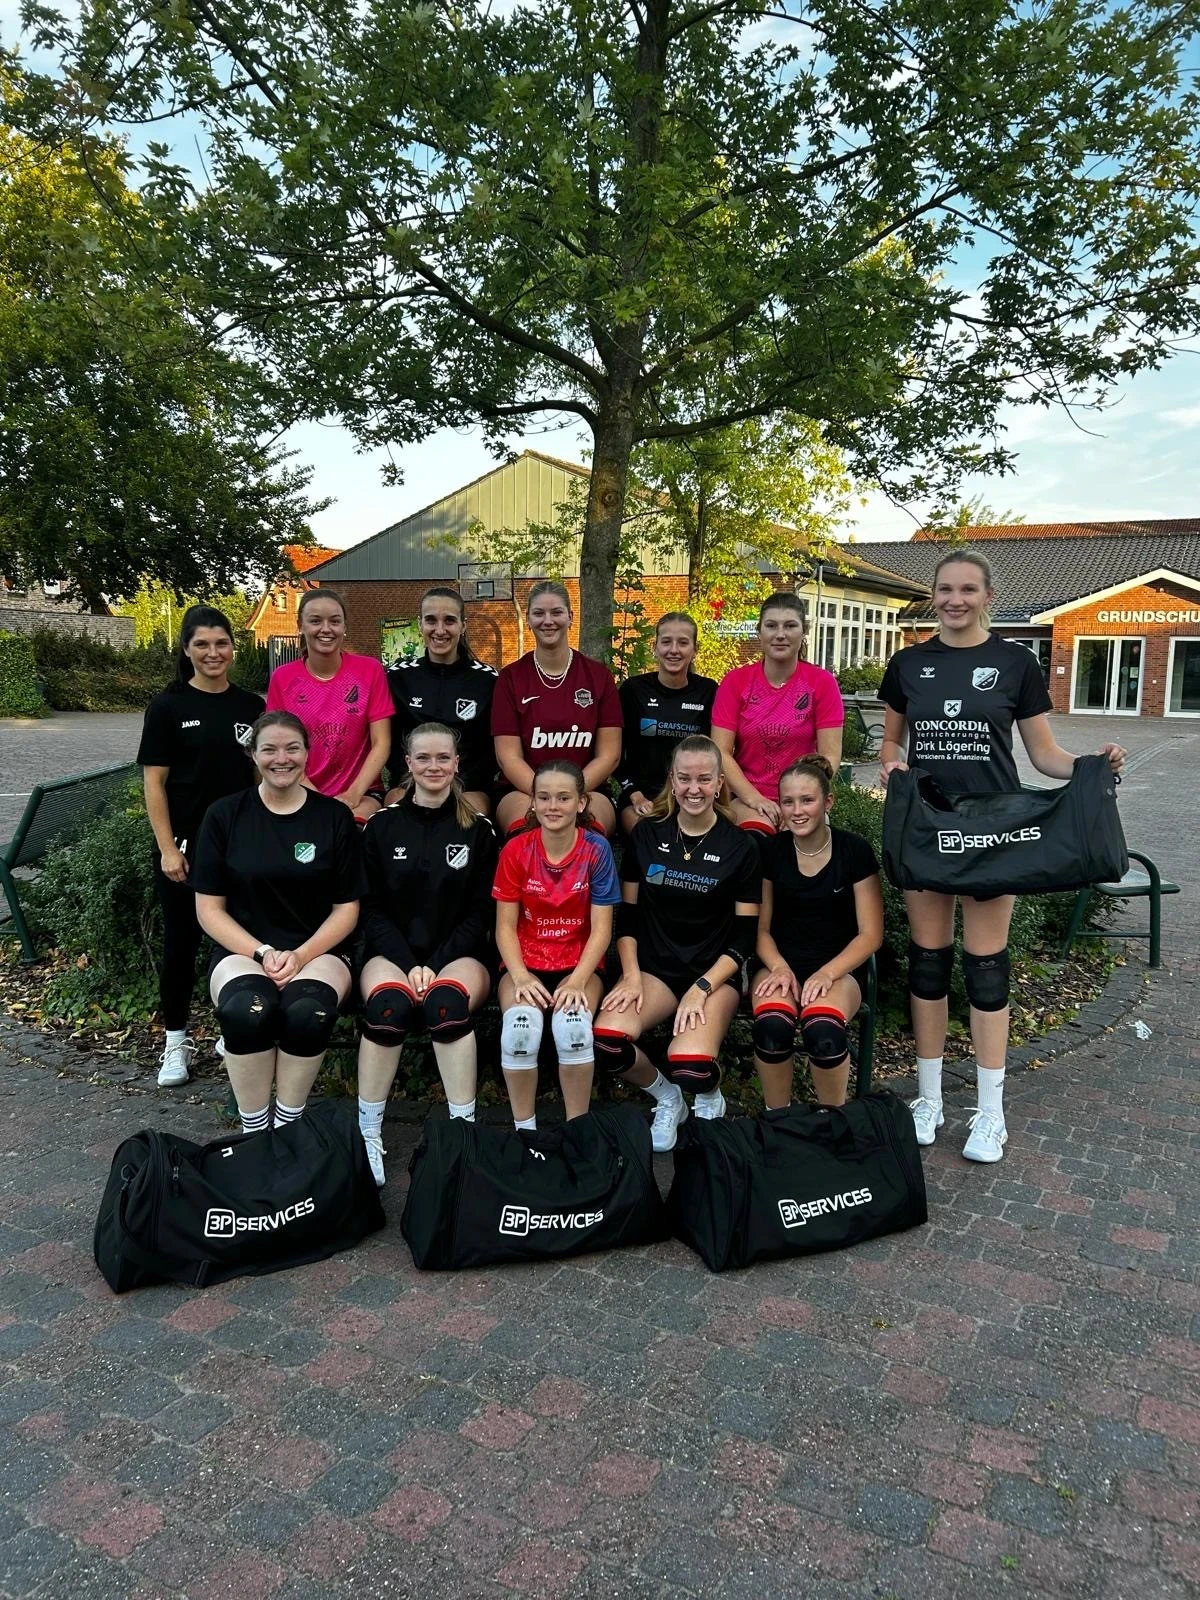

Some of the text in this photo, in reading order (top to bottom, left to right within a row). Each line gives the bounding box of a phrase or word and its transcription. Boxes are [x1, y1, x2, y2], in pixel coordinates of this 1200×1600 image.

[1097, 611, 1200, 623] GRUNDSCHU
[181, 720, 200, 728] JAKO
[658, 722, 702, 732] GRAFSCHAF
[915, 720, 989, 732] CONCORDIA
[530, 724, 593, 748] bwin
[916, 741, 991, 754] Dirk Lögering
[964, 827, 1041, 848] SERVICES
[703, 852, 720, 862] Lena
[666, 869, 719, 886] GRAFSCHAFT
[664, 877, 708, 893] BERATUNG
[537, 917, 584, 926] Sparkass
[537, 928, 570, 937] Lüneb
[800, 1187, 873, 1219] SERVICES
[236, 1197, 315, 1231] SERVICES
[529, 1209, 604, 1229] SERVICES
